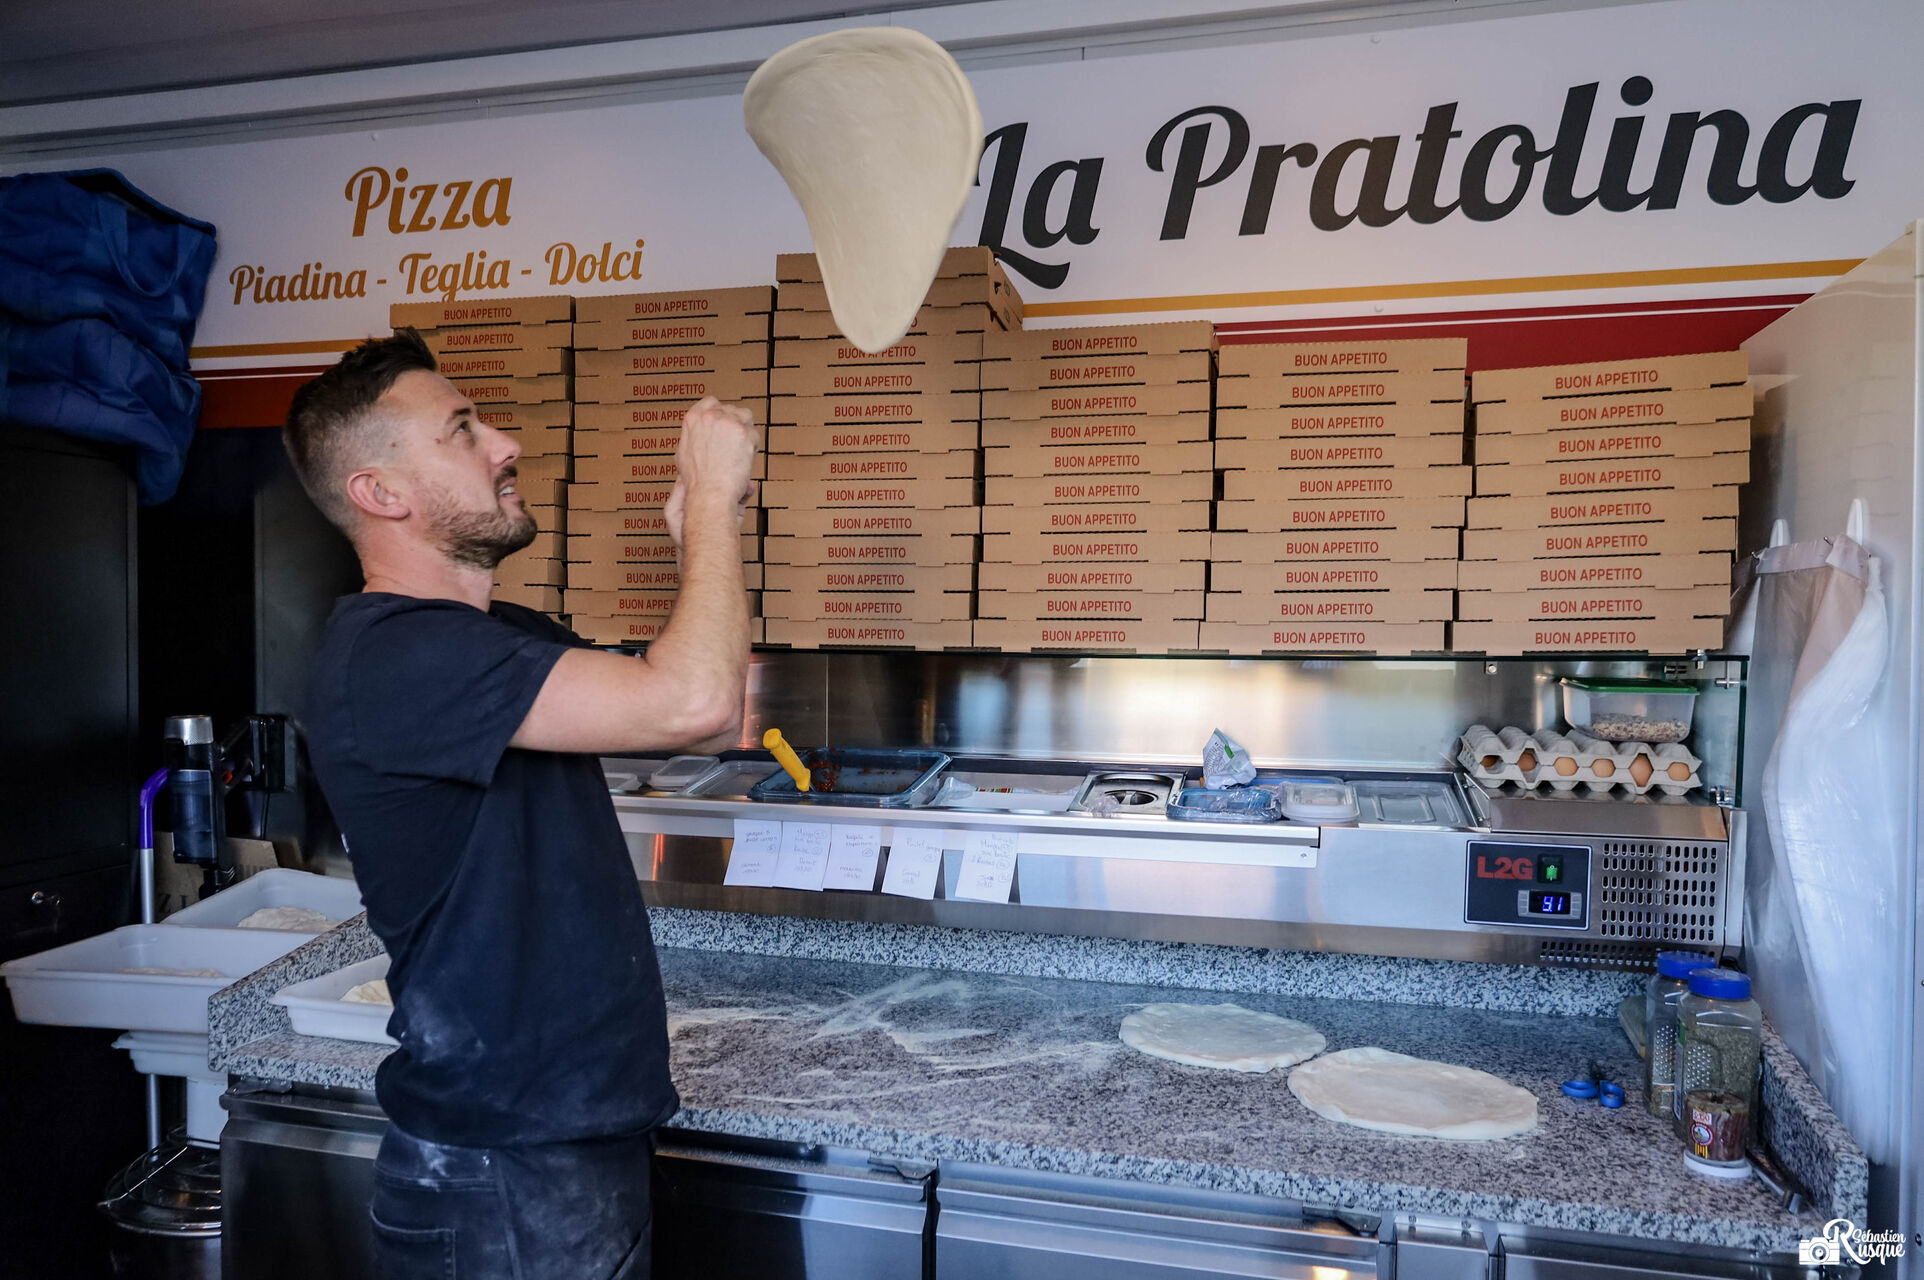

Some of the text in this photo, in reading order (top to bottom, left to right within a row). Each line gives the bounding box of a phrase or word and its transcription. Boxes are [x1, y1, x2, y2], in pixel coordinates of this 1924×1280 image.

[974, 75, 1864, 290] La Pratolina
[345, 166, 513, 238] Pizza
[229, 263, 367, 306] Piadina
[399, 250, 511, 304] Teglia
[544, 239, 645, 286] Dolci
[635, 299, 708, 314] BUON APPETITO
[444, 308, 512, 320] BUON APPETITO
[447, 334, 513, 345] BUON APPETITO
[632, 327, 705, 340] BUON APPETITO
[1053, 336, 1137, 351] BUON APPETITO
[838, 348, 866, 360] BUON
[1295, 352, 1388, 366] BUON APPETITO
[440, 360, 505, 373] BUON APPETITO
[633, 355, 705, 369] BUON APPETITO
[1050, 365, 1135, 380] BUON APPETITO
[834, 376, 912, 388] BUON APPETITO
[1555, 370, 1658, 390] BUON APPETITO
[468, 386, 510, 398] APPETITO
[633, 384, 704, 396] BUON APPETITO
[1292, 384, 1384, 398] BUON APPETITO
[1052, 396, 1136, 410] BUON APPETITO
[632, 410, 688, 422] BUON APPE
[834, 405, 912, 417] BUON APPETITO
[1561, 403, 1664, 422] BUON APPETITO
[478, 413, 512, 424] PPETITO
[1292, 416, 1384, 430] BUON APPETITO
[1051, 425, 1136, 438] BUON APPETITO
[632, 438, 657, 450] BUON
[832, 433, 910, 446] BUON APPETITO
[1559, 436, 1662, 453] BUON APPETITO
[1291, 448, 1383, 460] BUON APPETITO
[831, 461, 907, 474] BUON APPETITO
[1055, 455, 1140, 467] BUON APPETITO
[632, 464, 657, 476] BUON
[1560, 469, 1661, 485] BUON APPETITO
[1055, 485, 1140, 497] BUON APPETITO
[1300, 480, 1392, 493] BUON APPETITO
[625, 492, 650, 503] BUON
[826, 488, 906, 501] BUON APPETITO
[1293, 509, 1385, 523] BUON APPETITO
[1551, 502, 1652, 519] BUON APPETITO
[624, 519, 649, 528] BUON
[833, 517, 912, 529] BUON APPETITO
[1052, 512, 1136, 526] BUON APPETITO
[1287, 541, 1378, 554] BUON APPETITO
[1547, 534, 1648, 550] BUON APPETITO
[624, 546, 675, 557] BUON APPE
[828, 546, 905, 558] BUON APPETITO
[1053, 544, 1138, 556] BUON APPETITO
[625, 573, 677, 584] BUON APPE
[827, 574, 904, 586] BUON APPETITO
[1048, 573, 1132, 584] BUON APPETITO
[1287, 571, 1378, 584] BUON APPETITO
[1541, 568, 1643, 582] BUON APPETITO
[619, 598, 672, 610] BUON APPET
[824, 601, 902, 614] BUON APPETITO
[1048, 600, 1132, 612] BUON APPETITO
[1281, 603, 1373, 615] BUON APPETITO
[1542, 600, 1642, 613] BUON APPETITO
[629, 625, 656, 635] BUON
[828, 628, 905, 640] BUON APPETITO
[1042, 630, 1126, 642] BUON APPETITO
[1273, 632, 1365, 644] BUON APPETITO
[1536, 632, 1636, 644] BUON APPETITO
[1477, 856, 1534, 881] L2G
